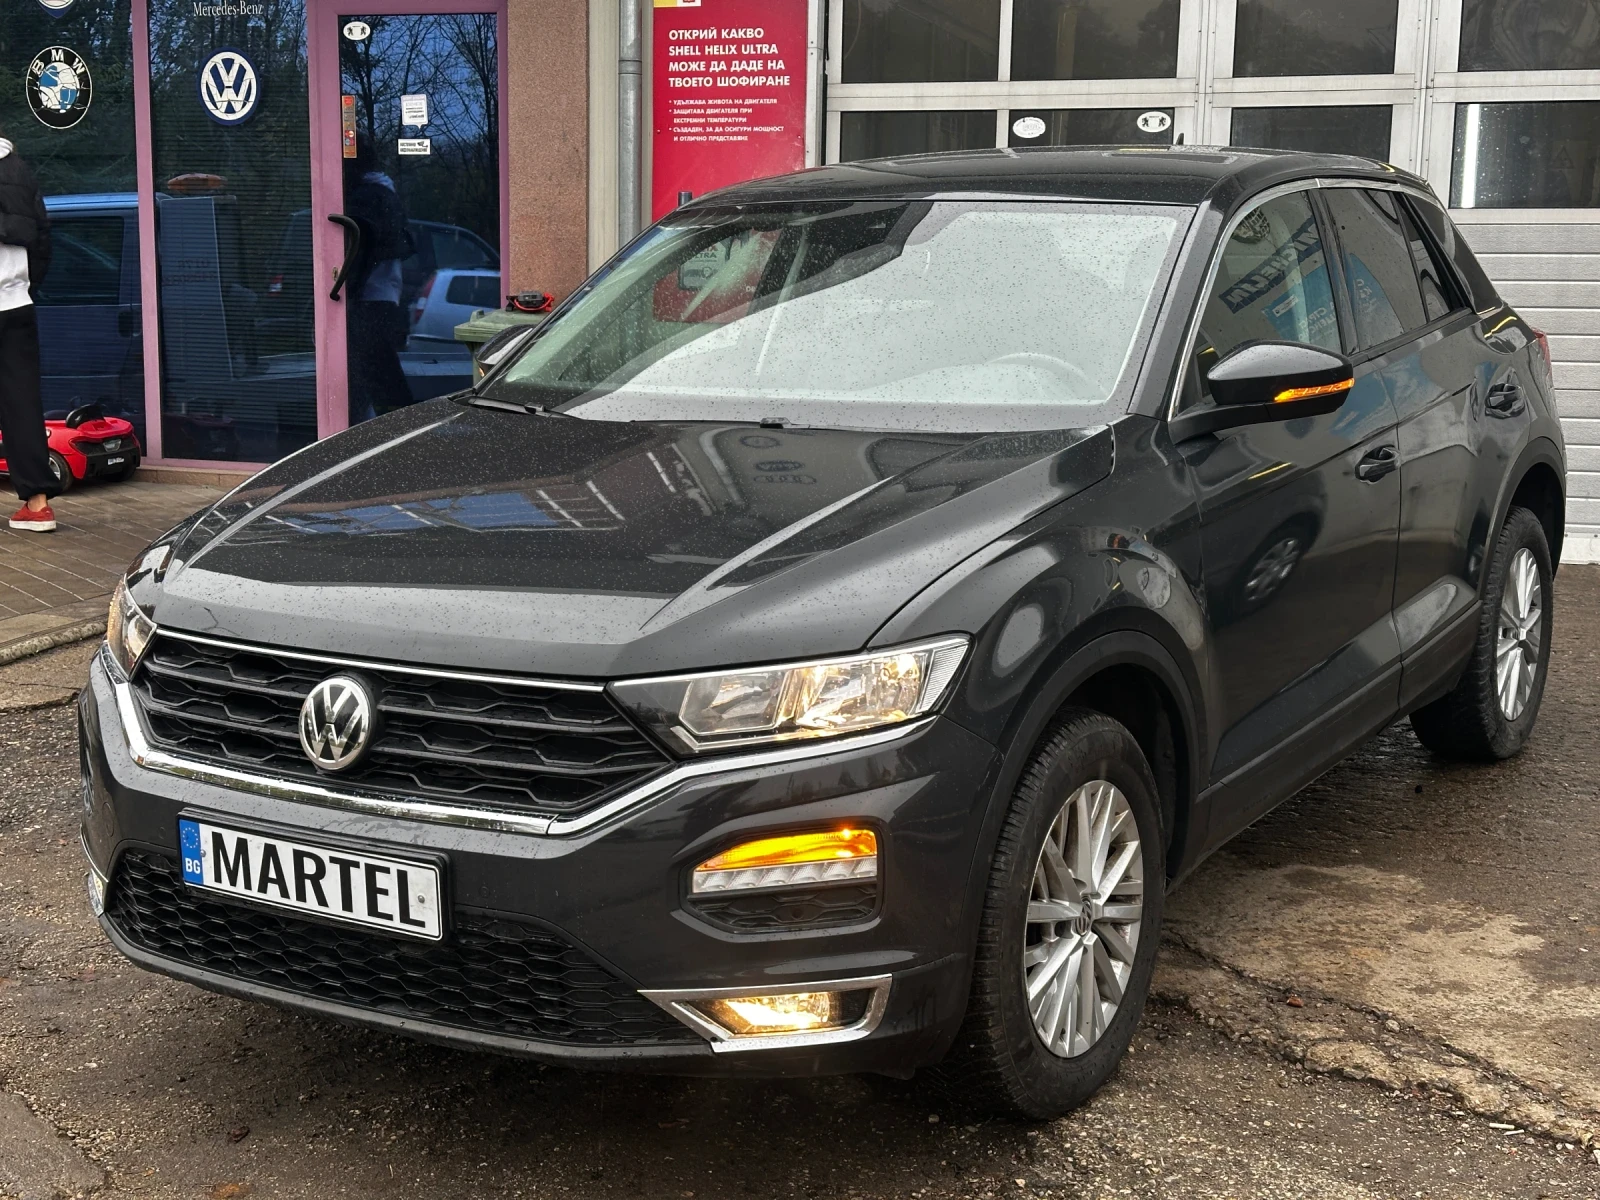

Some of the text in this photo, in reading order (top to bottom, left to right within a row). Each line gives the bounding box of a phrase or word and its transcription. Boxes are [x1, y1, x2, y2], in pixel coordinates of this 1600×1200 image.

[193, 0, 264, 16] Mercedes-Benz
[669, 27, 764, 40] ОТКРИЙ КАКВО
[668, 43, 779, 56] SHELL HELIX ULTRA
[31, 49, 86, 77] BMW
[668, 60, 785, 73] МОЖЕ ДА ДАДЕ НА
[668, 76, 790, 88] ТВОЕТО ШОФИРАНЕ
[185, 857, 201, 875] BG
[211, 831, 426, 928] MARTEL
